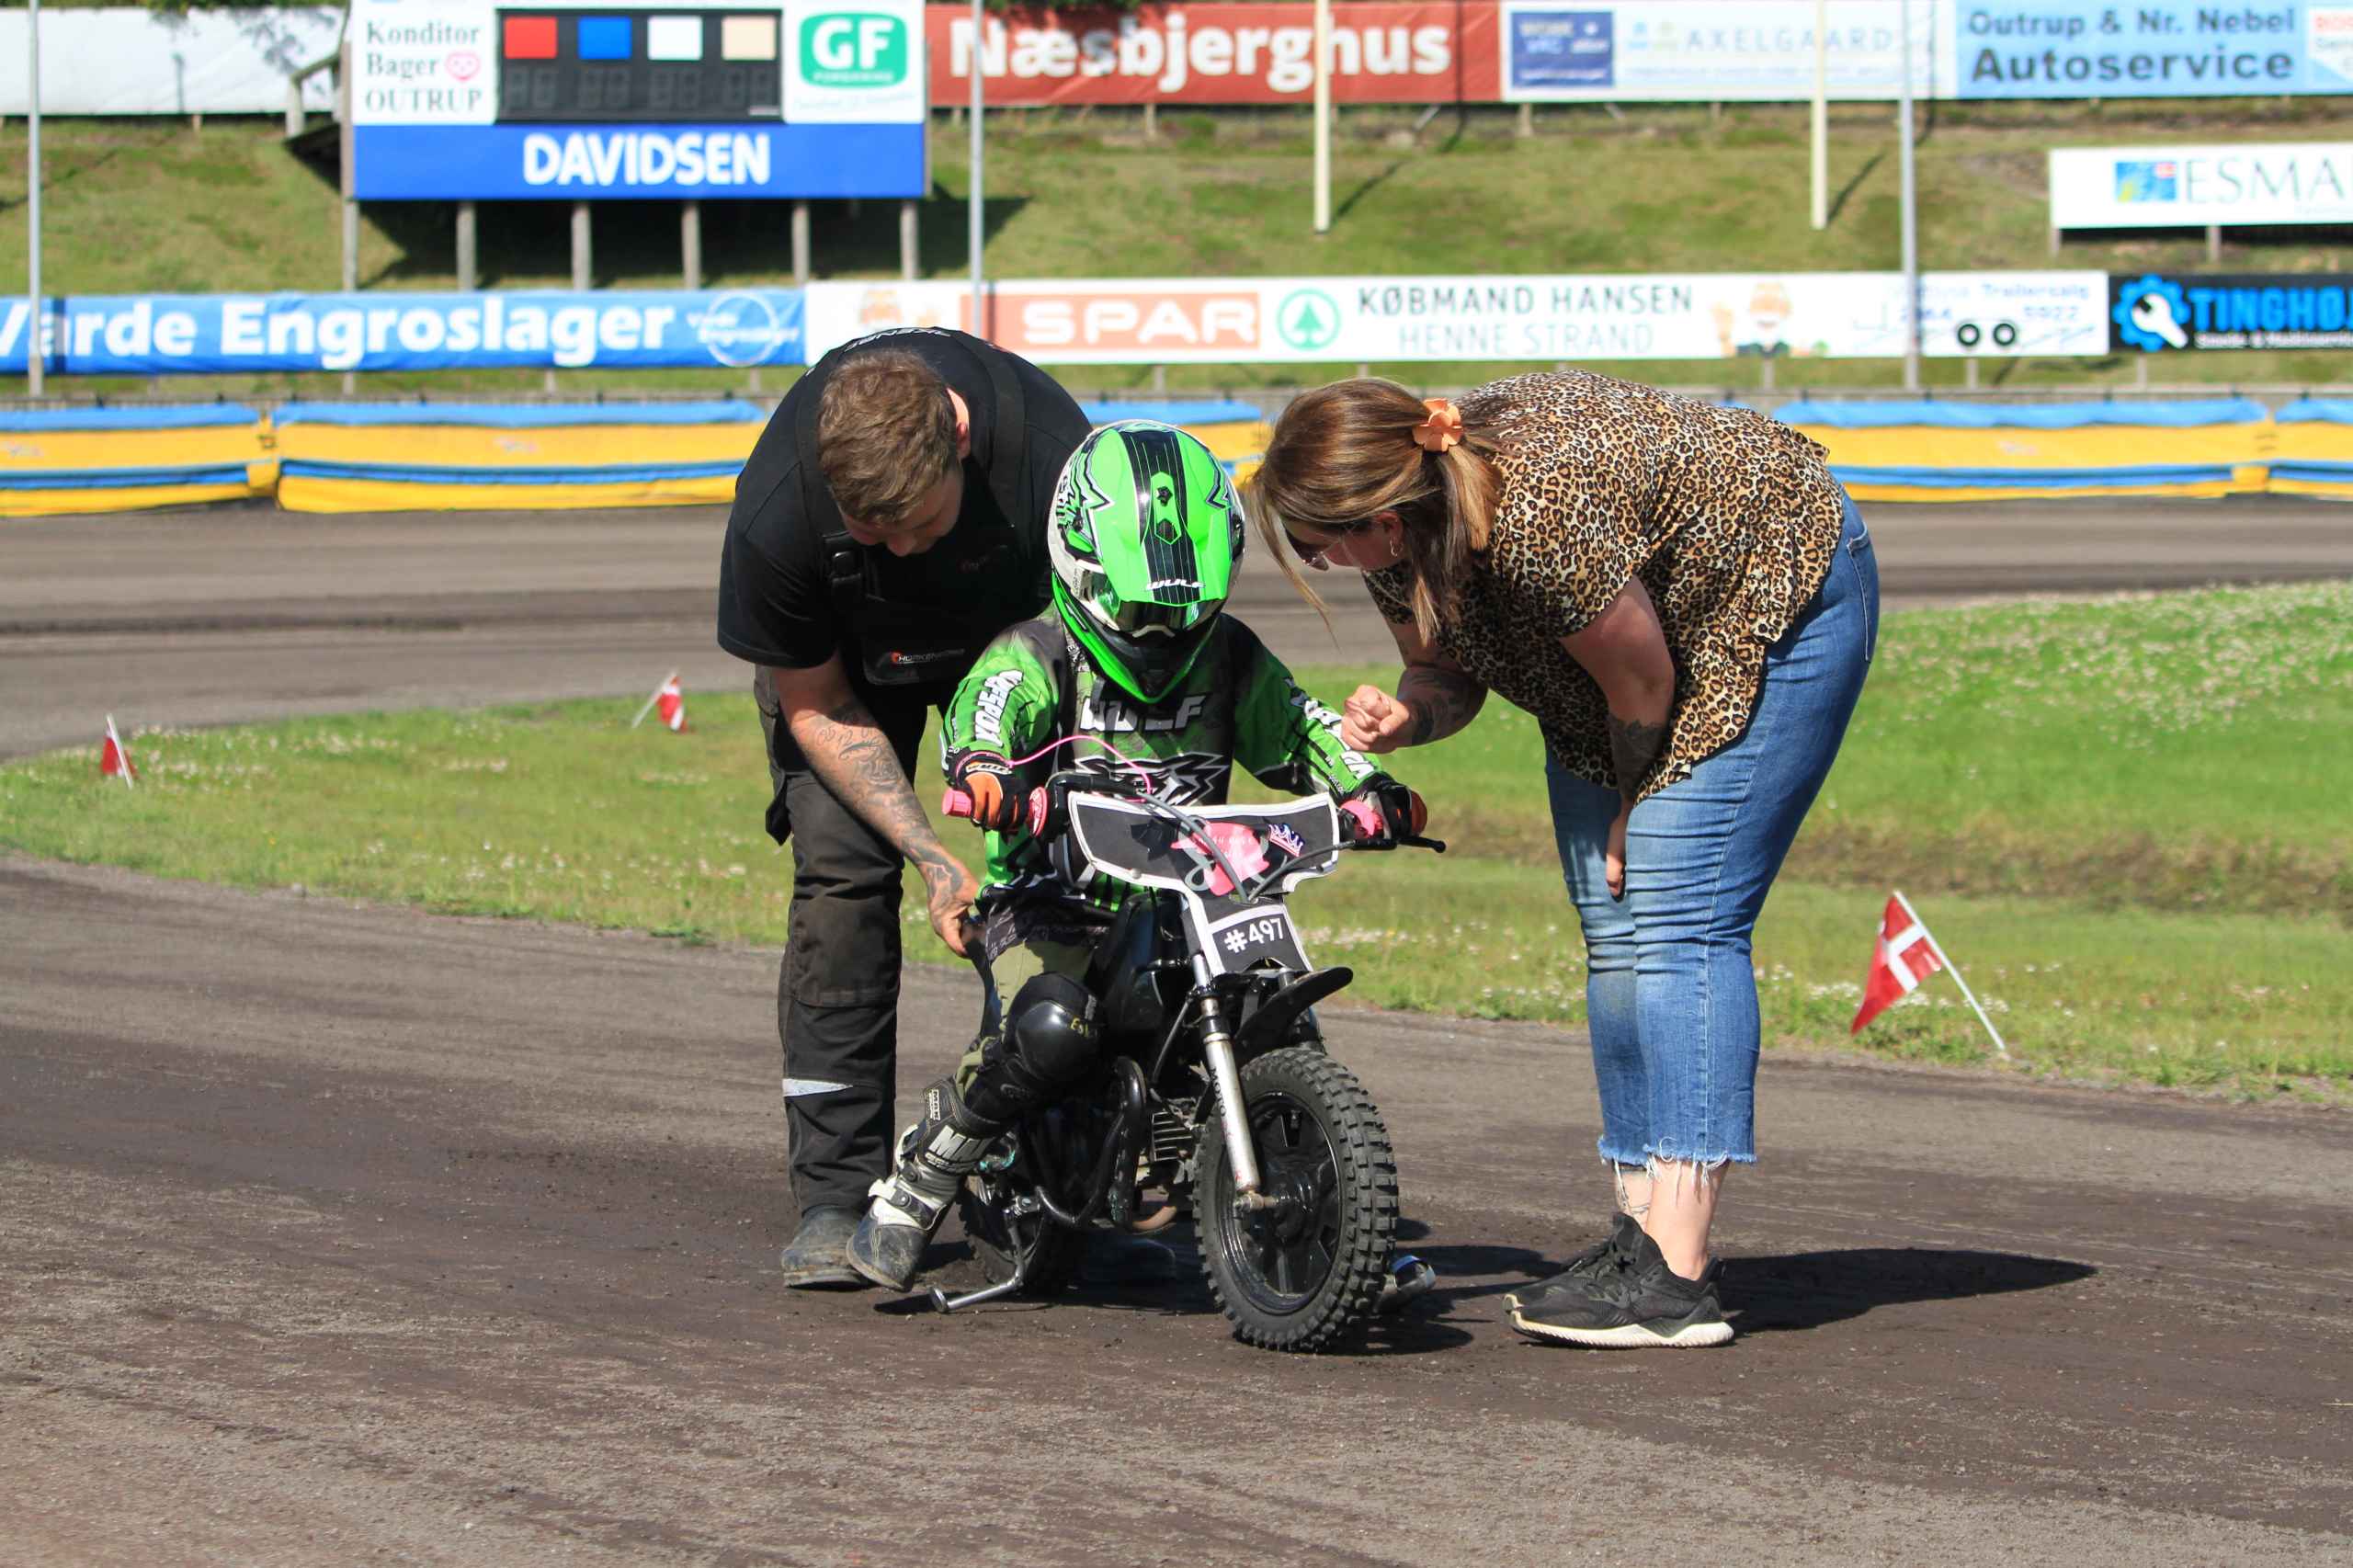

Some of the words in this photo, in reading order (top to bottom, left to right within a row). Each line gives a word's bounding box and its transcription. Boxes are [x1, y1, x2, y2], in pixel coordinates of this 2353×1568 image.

[366, 20, 481, 44] Konditor
[1969, 10, 2085, 40] Outrup
[2099, 9, 2121, 35] &
[2138, 9, 2183, 35] Nr.
[2198, 7, 2295, 34] Nebel
[812, 17, 894, 70] GF
[949, 14, 1452, 92] Næsbjerghus
[1972, 43, 2294, 82] Autoservice
[366, 52, 438, 79] Bager
[366, 89, 483, 113] OUTRUP
[523, 132, 771, 186] DAVIDSEN
[1358, 285, 1534, 317] KØBMAND
[1552, 283, 1692, 314] HANSEN
[2188, 286, 2353, 332] TINGHO
[221, 296, 676, 369] Engroslager
[1023, 299, 1256, 345] SPAR
[1399, 324, 1510, 356] HENNE
[1524, 322, 1654, 354] STRAND
[1223, 917, 1284, 954] #497
